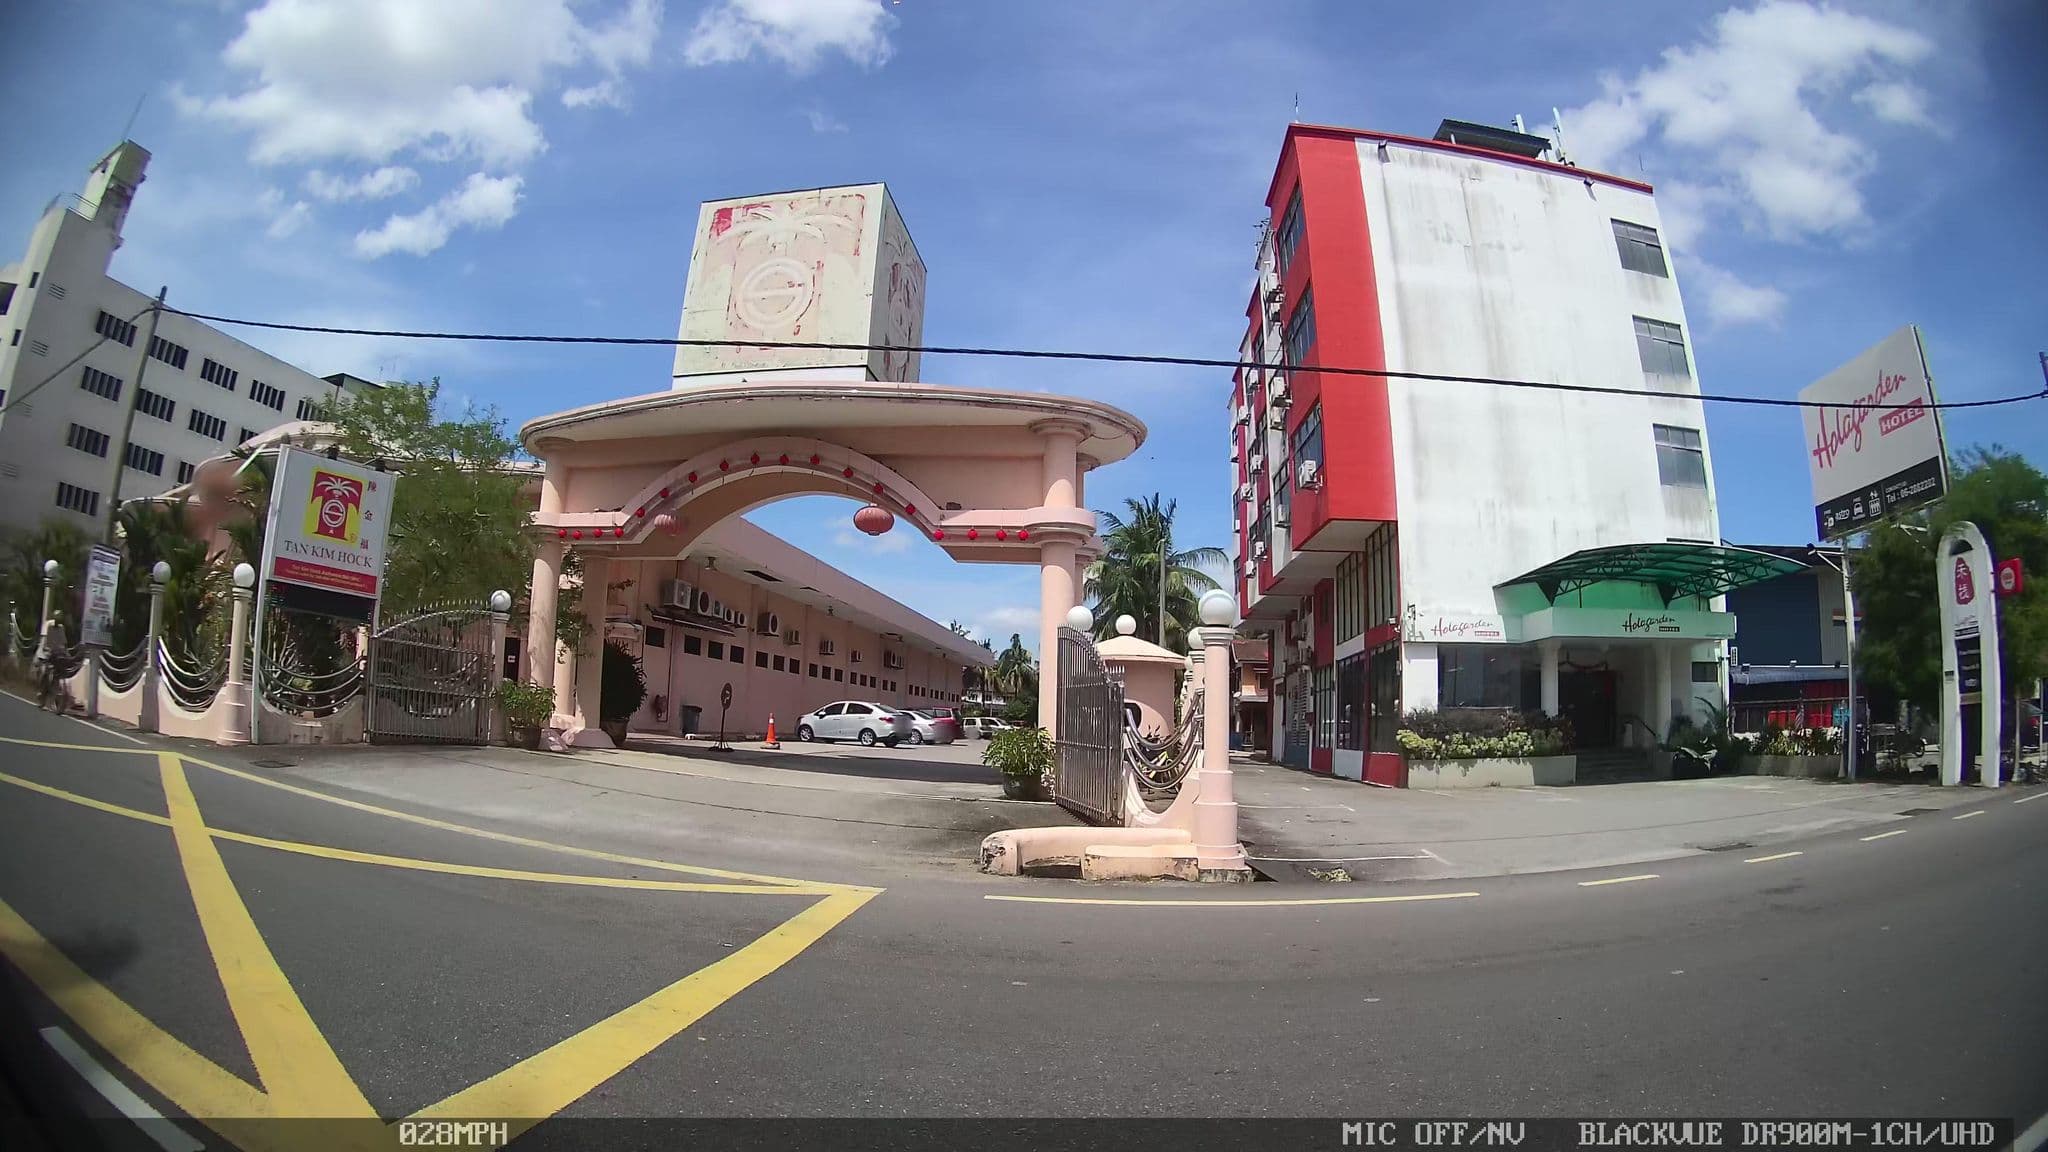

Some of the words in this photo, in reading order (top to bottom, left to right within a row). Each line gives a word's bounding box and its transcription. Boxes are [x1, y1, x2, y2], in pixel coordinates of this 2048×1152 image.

[1812, 369, 1907, 469] Holagarden
[1881, 404, 1923, 432] HOTEL
[284, 539, 309, 555] TAN
[311, 545, 336, 560] KIM
[337, 551, 373, 568] HOCK
[1430, 617, 1494, 637] Holagarden
[1621, 612, 1676, 633] Holagarden
